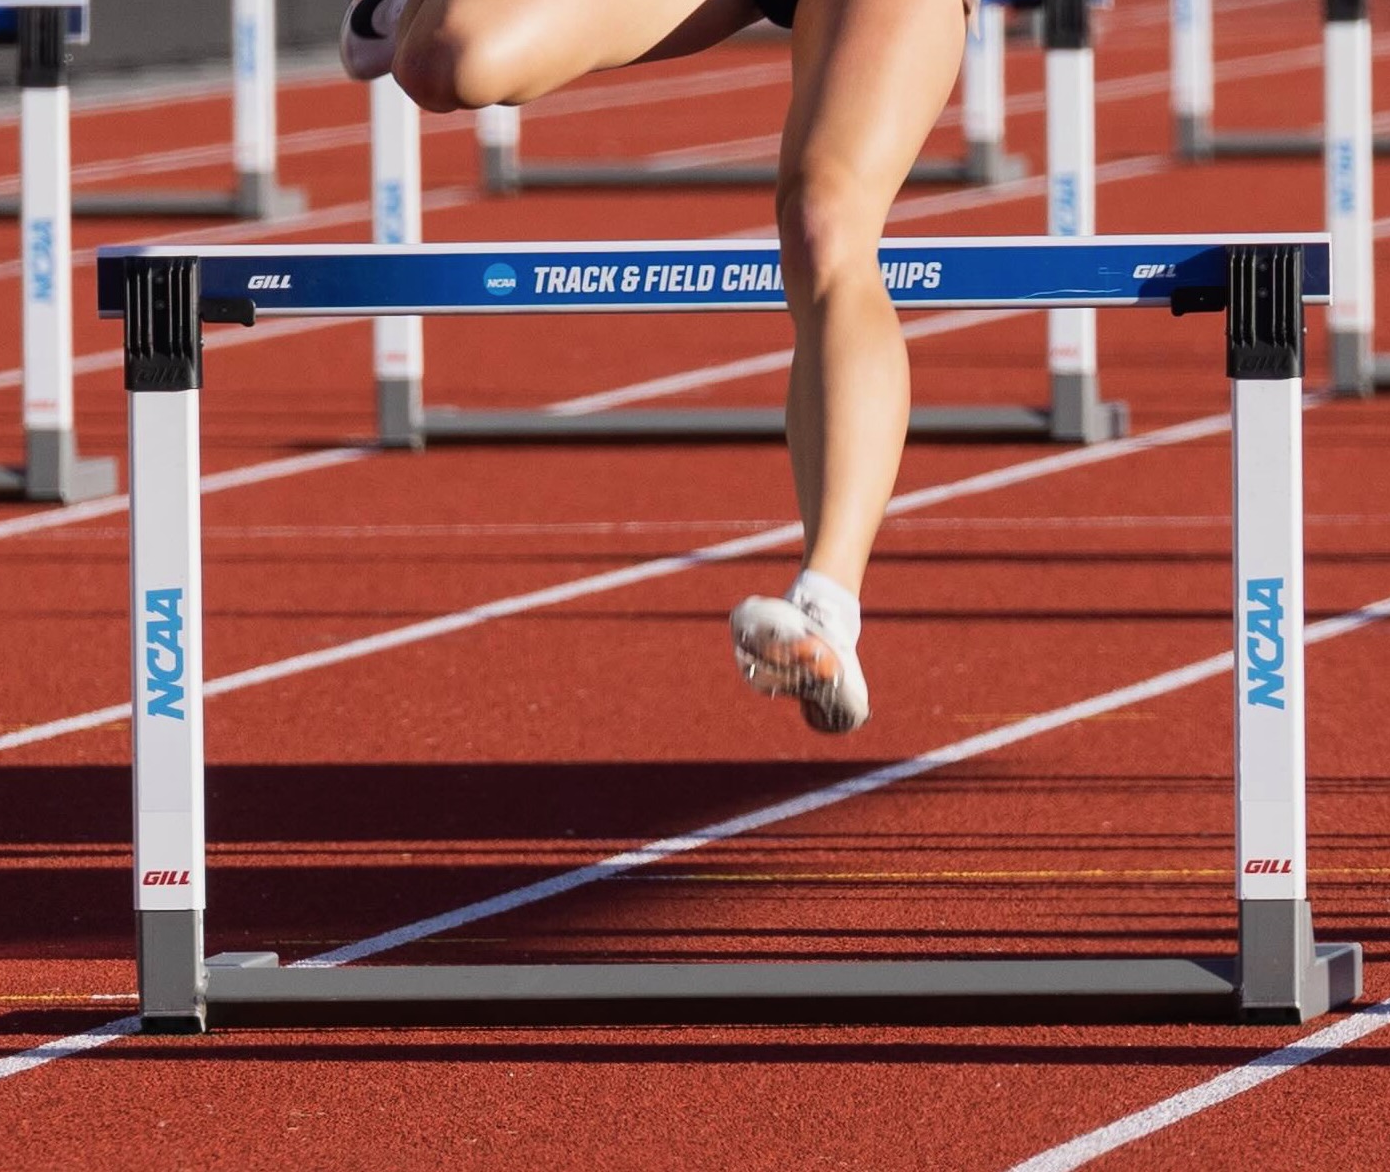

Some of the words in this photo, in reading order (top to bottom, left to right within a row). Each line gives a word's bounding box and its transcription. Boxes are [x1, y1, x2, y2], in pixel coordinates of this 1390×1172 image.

[534, 266, 618, 293] TRACK
[620, 265, 641, 292] &
[644, 265, 716, 292] FIELD
[1133, 264, 1177, 279] GILL
[247, 274, 291, 289] GILL
[487, 278, 516, 288] NCAA
[1247, 577, 1285, 710] NCAA
[145, 588, 184, 720] NCAA
[1244, 859, 1292, 874] GILL
[142, 870, 190, 886] GILL
